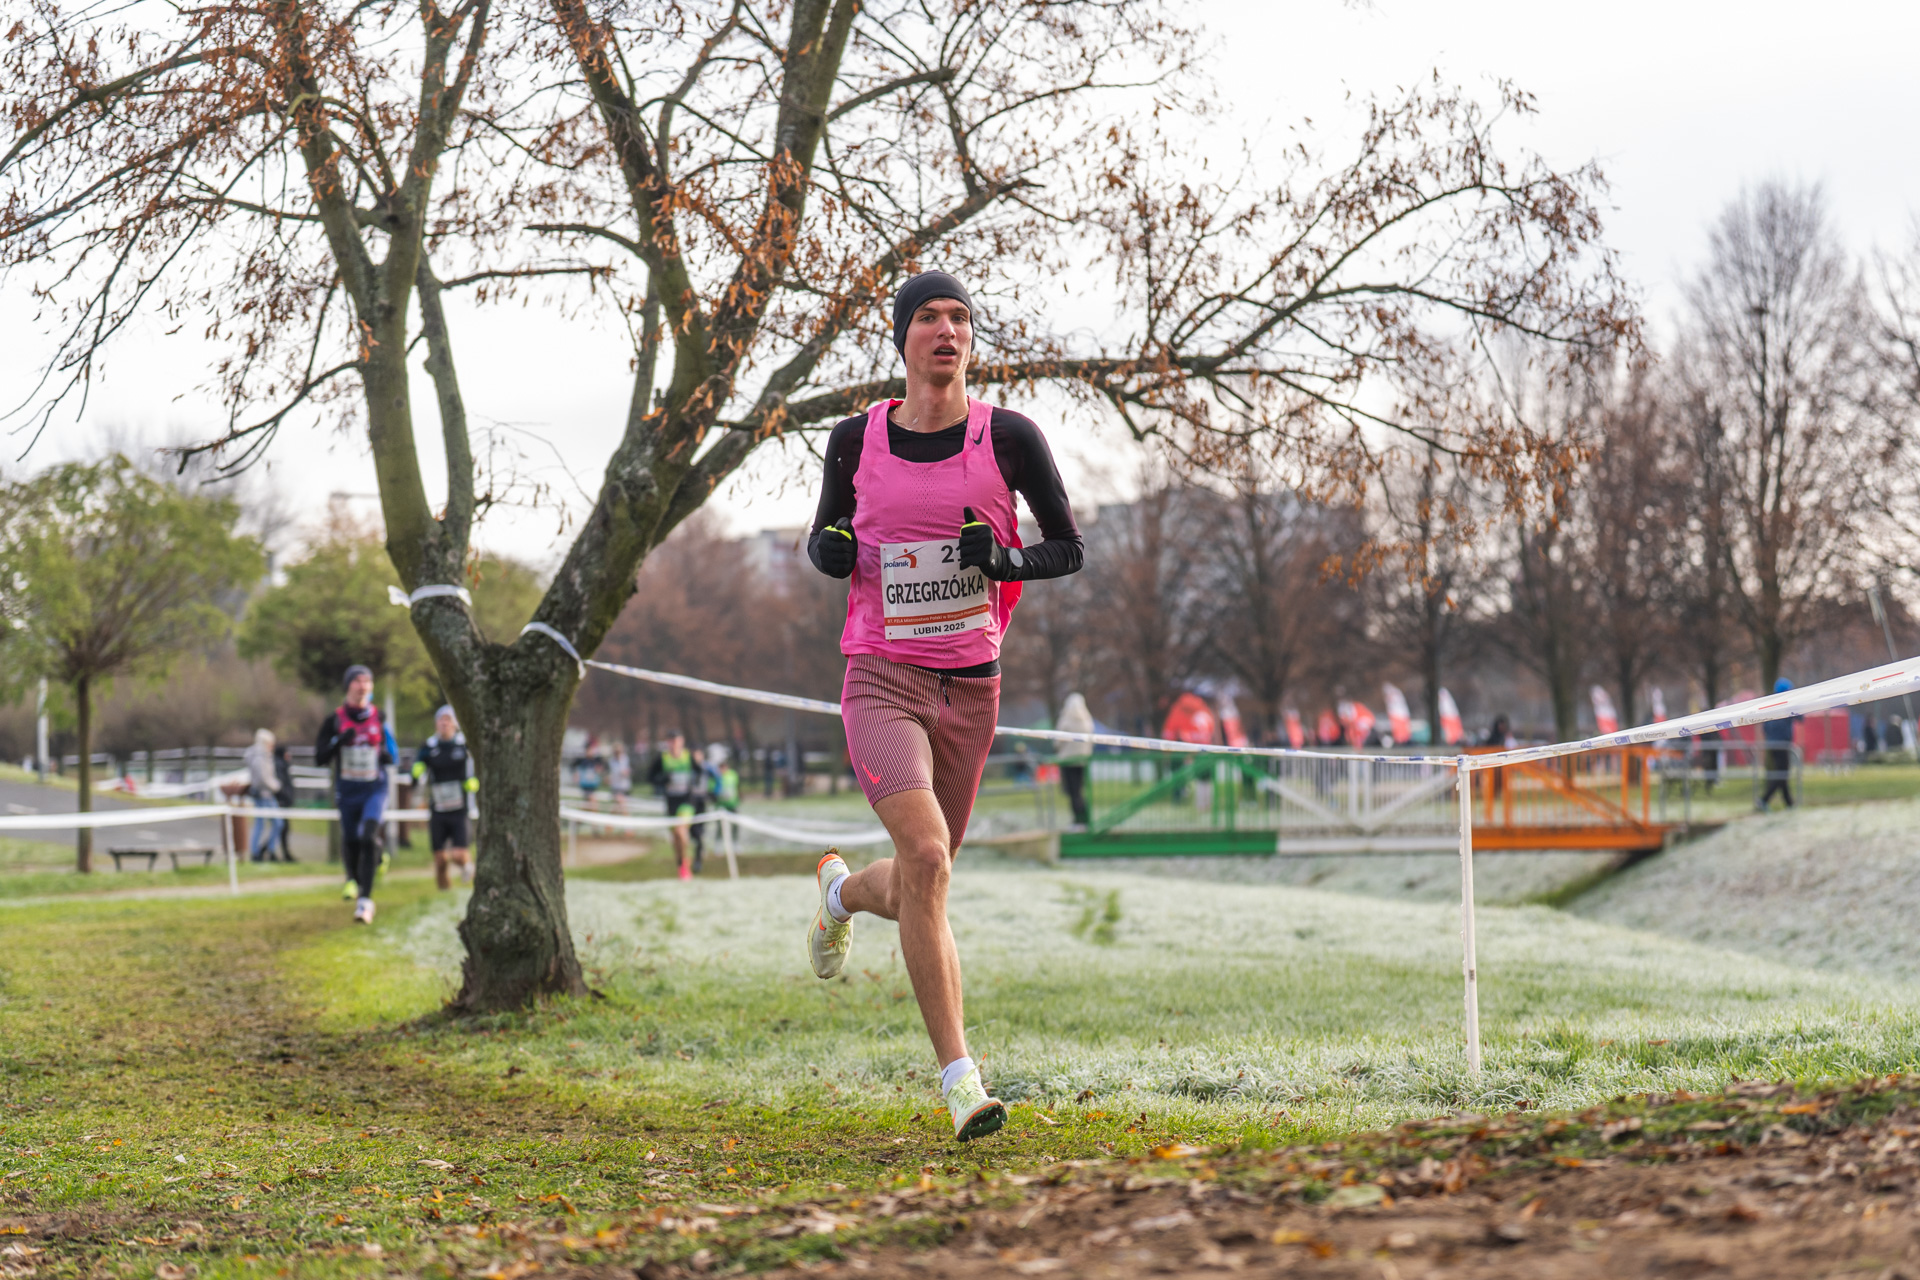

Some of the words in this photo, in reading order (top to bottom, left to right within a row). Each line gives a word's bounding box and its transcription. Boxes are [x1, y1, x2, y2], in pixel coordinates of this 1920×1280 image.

[884, 560, 909, 569] polanik
[886, 574, 985, 605] GRZEGRZÓŁKA
[913, 626, 942, 635] LUBIN
[943, 621, 965, 632] 2025
